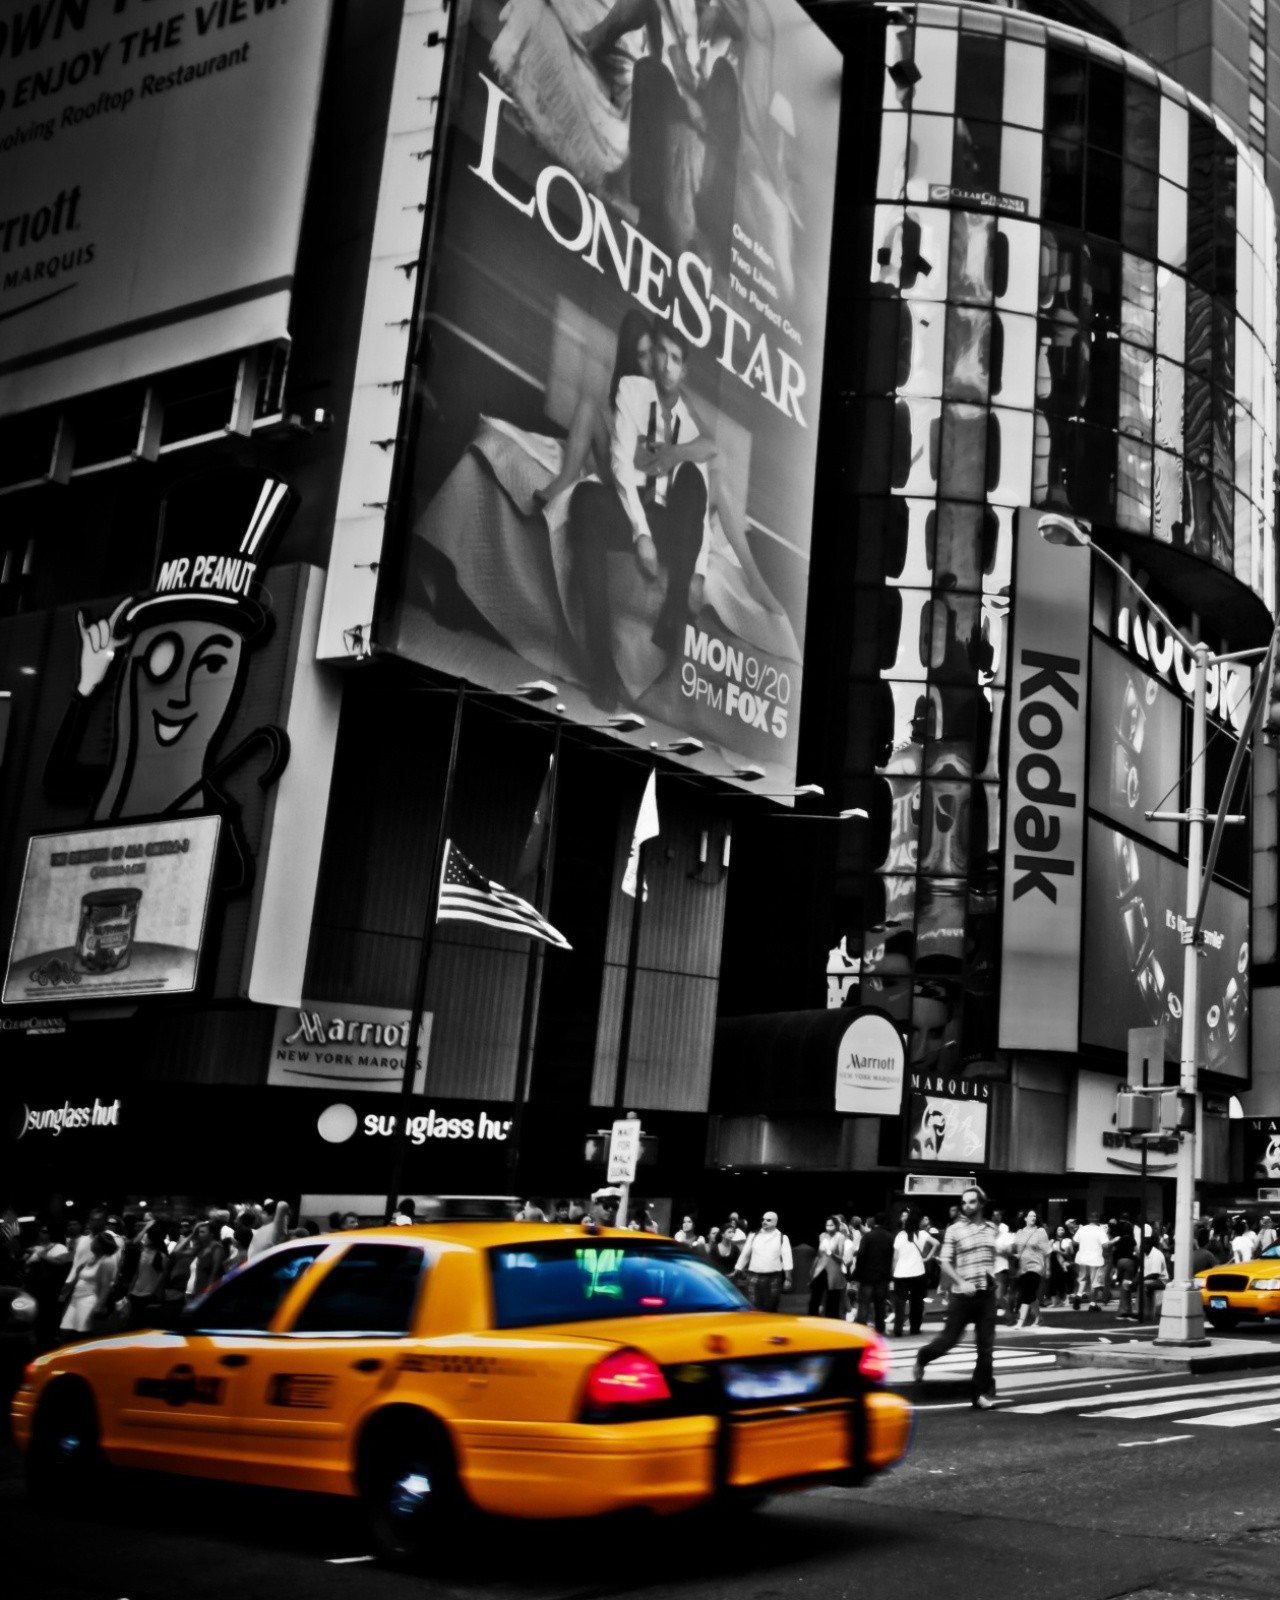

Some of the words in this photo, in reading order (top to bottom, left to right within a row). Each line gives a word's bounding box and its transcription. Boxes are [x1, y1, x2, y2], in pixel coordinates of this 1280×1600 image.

[13, 43, 110, 108] ENJOY
[120, 14, 184, 64] THE
[61, 85, 134, 129] Rooftop
[140, 41, 251, 99] Restaurant
[733, 223, 752, 250] One
[3, 242, 95, 292] MARQUIS
[731, 247, 751, 275] Two
[730, 273, 747, 299] The
[749, 286, 781, 330] Perfect
[156, 557, 189, 592] MR.
[190, 555, 257, 596] PEANUT
[684, 624, 744, 682] MON
[744, 656, 791, 705] 9/20
[681, 662, 723, 711] 9PM
[1013, 648, 1081, 905] Kodak
[276, 1050, 310, 1062] NEW
[314, 1053, 353, 1065] YORK
[358, 1056, 422, 1071] MARQUS
[846, 1052, 895, 1071] Marriott
[855, 1073, 872, 1081] YORK
[911, 1073, 989, 1098] MARQUIS
[28, 1099, 90, 1137] sunglass
[91, 1097, 122, 1127] hut
[477, 1111, 514, 1141] hu
[617, 1127, 634, 1137] WAIT
[613, 1155, 632, 1164] WALK
[617, 1140, 631, 1150] FOR
